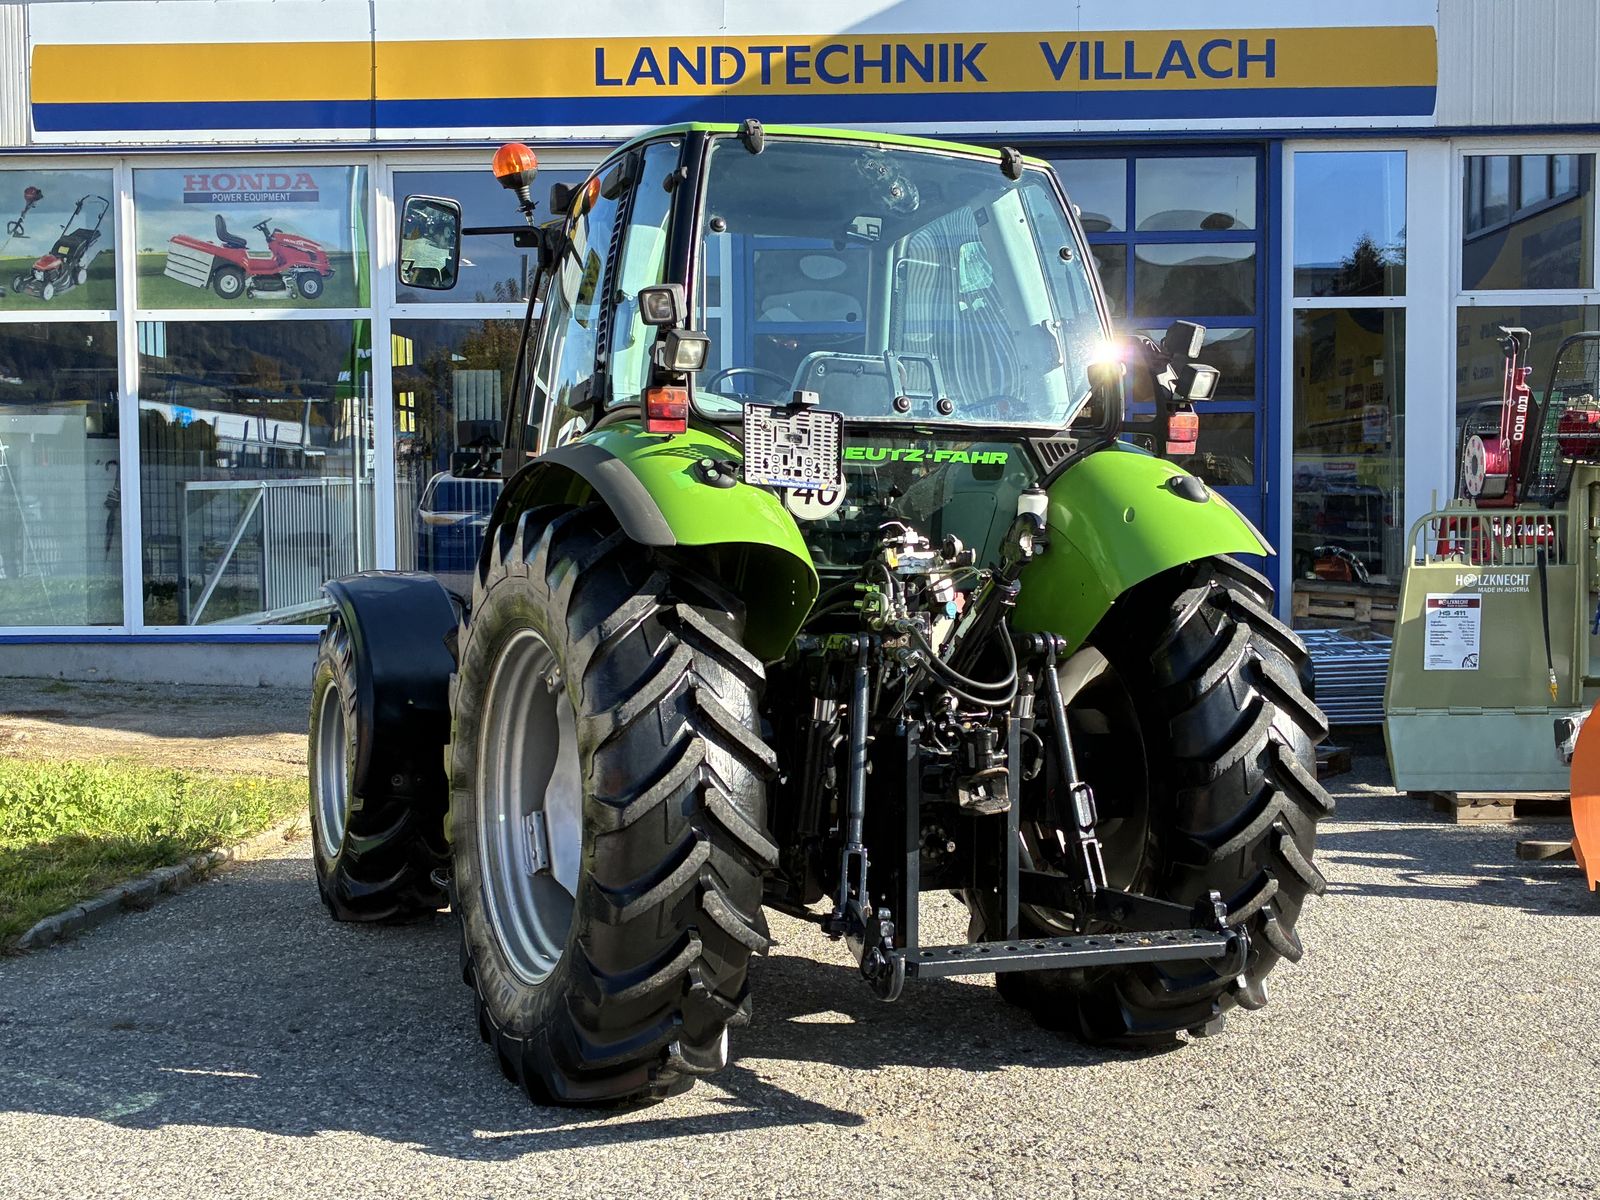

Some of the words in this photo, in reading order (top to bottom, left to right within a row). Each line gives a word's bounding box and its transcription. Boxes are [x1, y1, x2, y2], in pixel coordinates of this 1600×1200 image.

[594, 42, 988, 86] LANDTECHNIK
[1038, 38, 1276, 81] VILLACH
[183, 173, 319, 191] HONDA
[212, 193, 242, 201] POWER
[243, 192, 291, 201] EQUIPMENT
[1517, 395, 1529, 412] RS
[1512, 415, 1525, 441] 500
[842, 447, 1008, 464] EUTZ-FAHR
[1455, 573, 1531, 587] HOLZKNECHT
